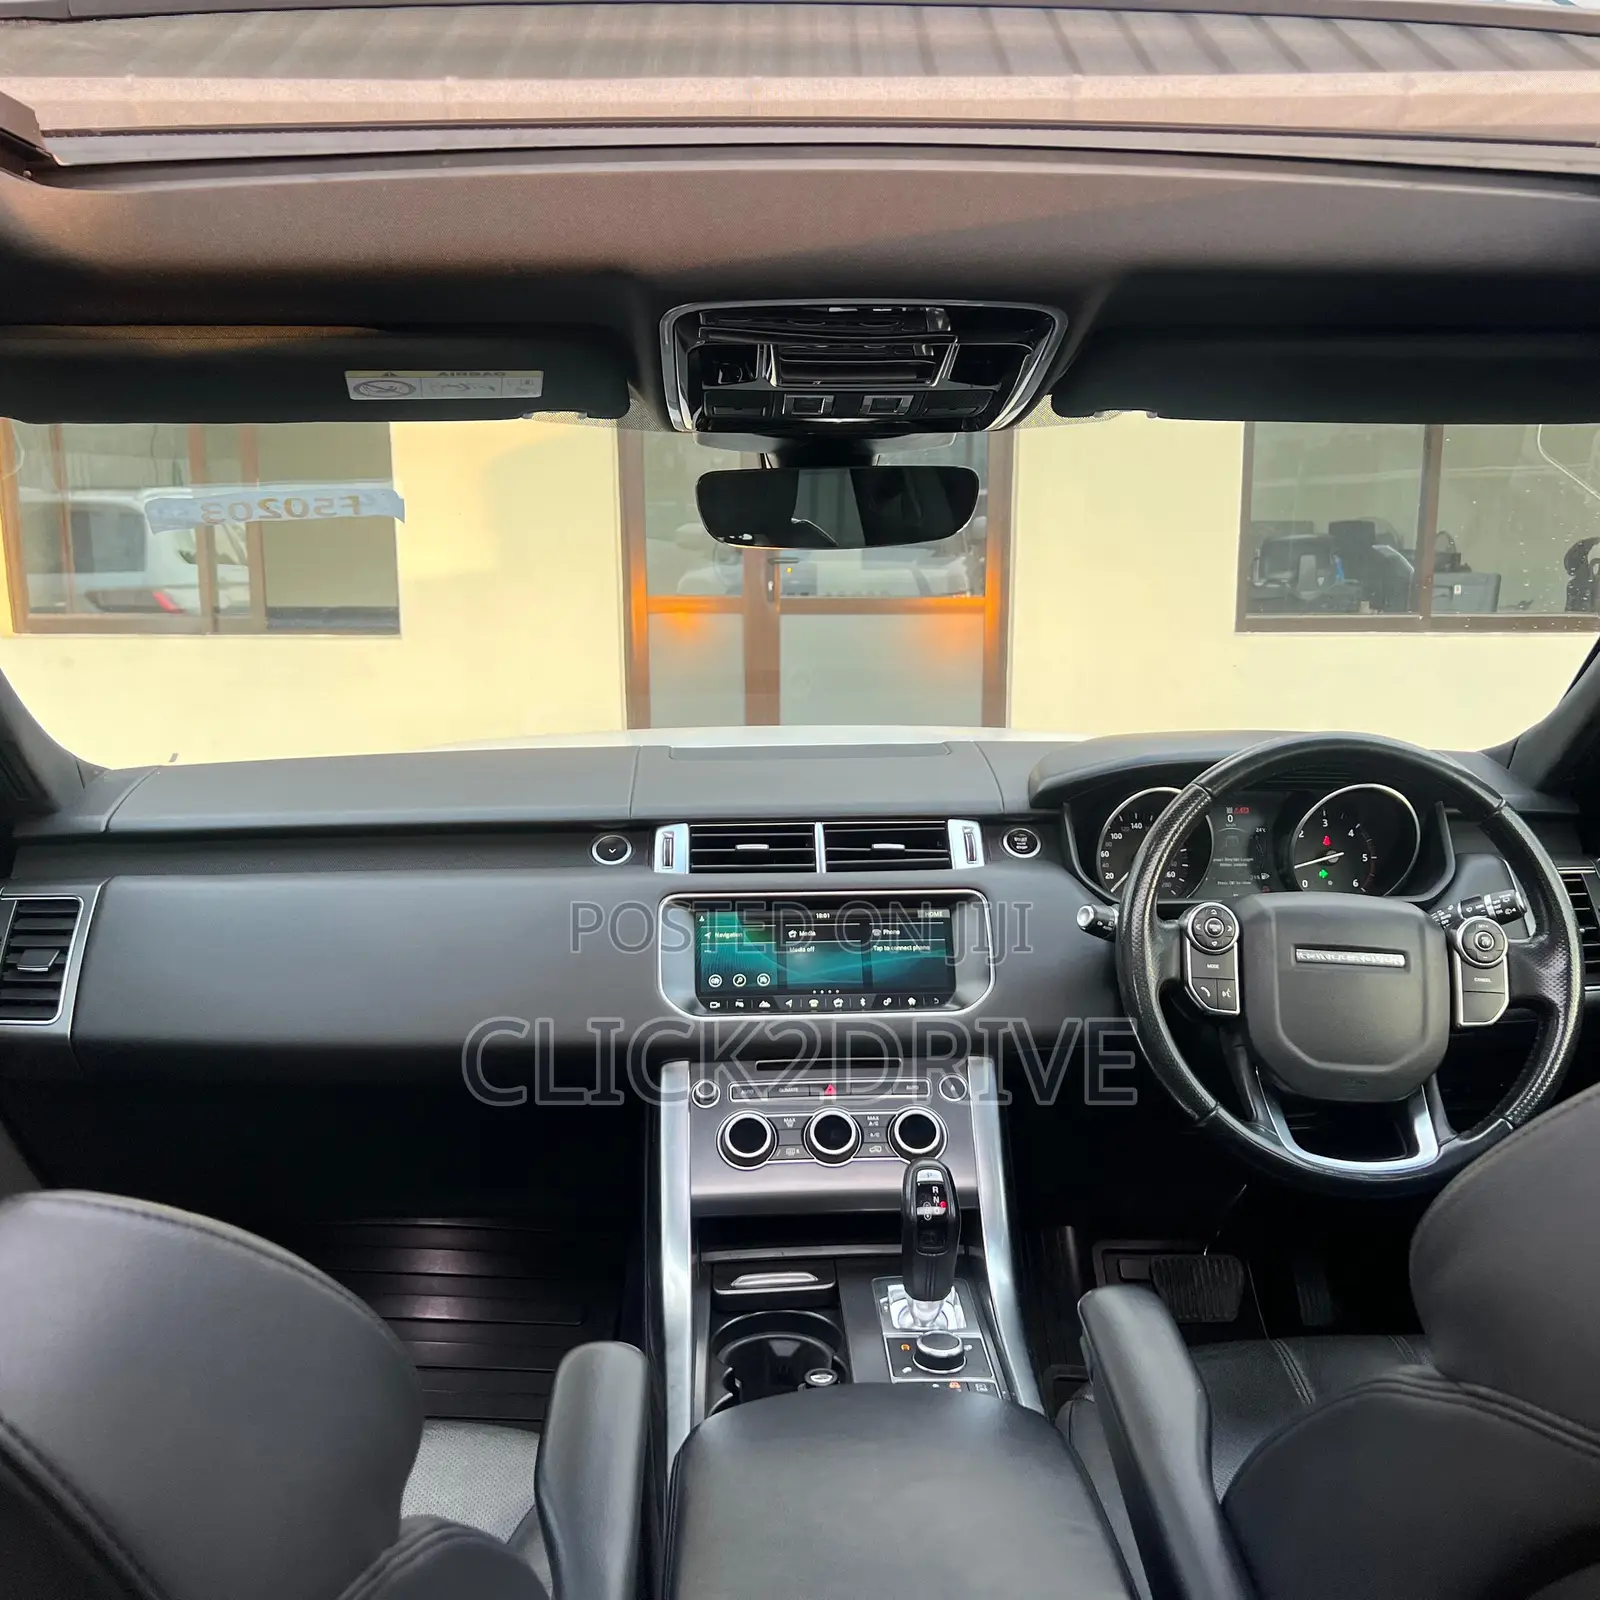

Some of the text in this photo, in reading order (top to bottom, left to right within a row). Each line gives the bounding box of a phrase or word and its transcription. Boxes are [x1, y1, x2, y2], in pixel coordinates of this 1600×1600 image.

[1227, 814, 1234, 823] 0
[1130, 822, 1143, 830] 140
[1322, 819, 1329, 828] 3
[1110, 832, 1123, 840] 100
[1298, 830, 1305, 838] 2
[1347, 828, 1355, 838] 4
[1100, 850, 1110, 858] 60
[1362, 853, 1368, 862] 5
[1104, 872, 1115, 880] 20
[1301, 879, 1309, 888] 0
[1352, 878, 1359, 888] 6
[924, 910, 943, 918] HOME
[714, 931, 743, 939] Navigation
[912, 944, 931, 952] phone
[932, 1185, 939, 1194] R
[933, 1195, 940, 1204] N
